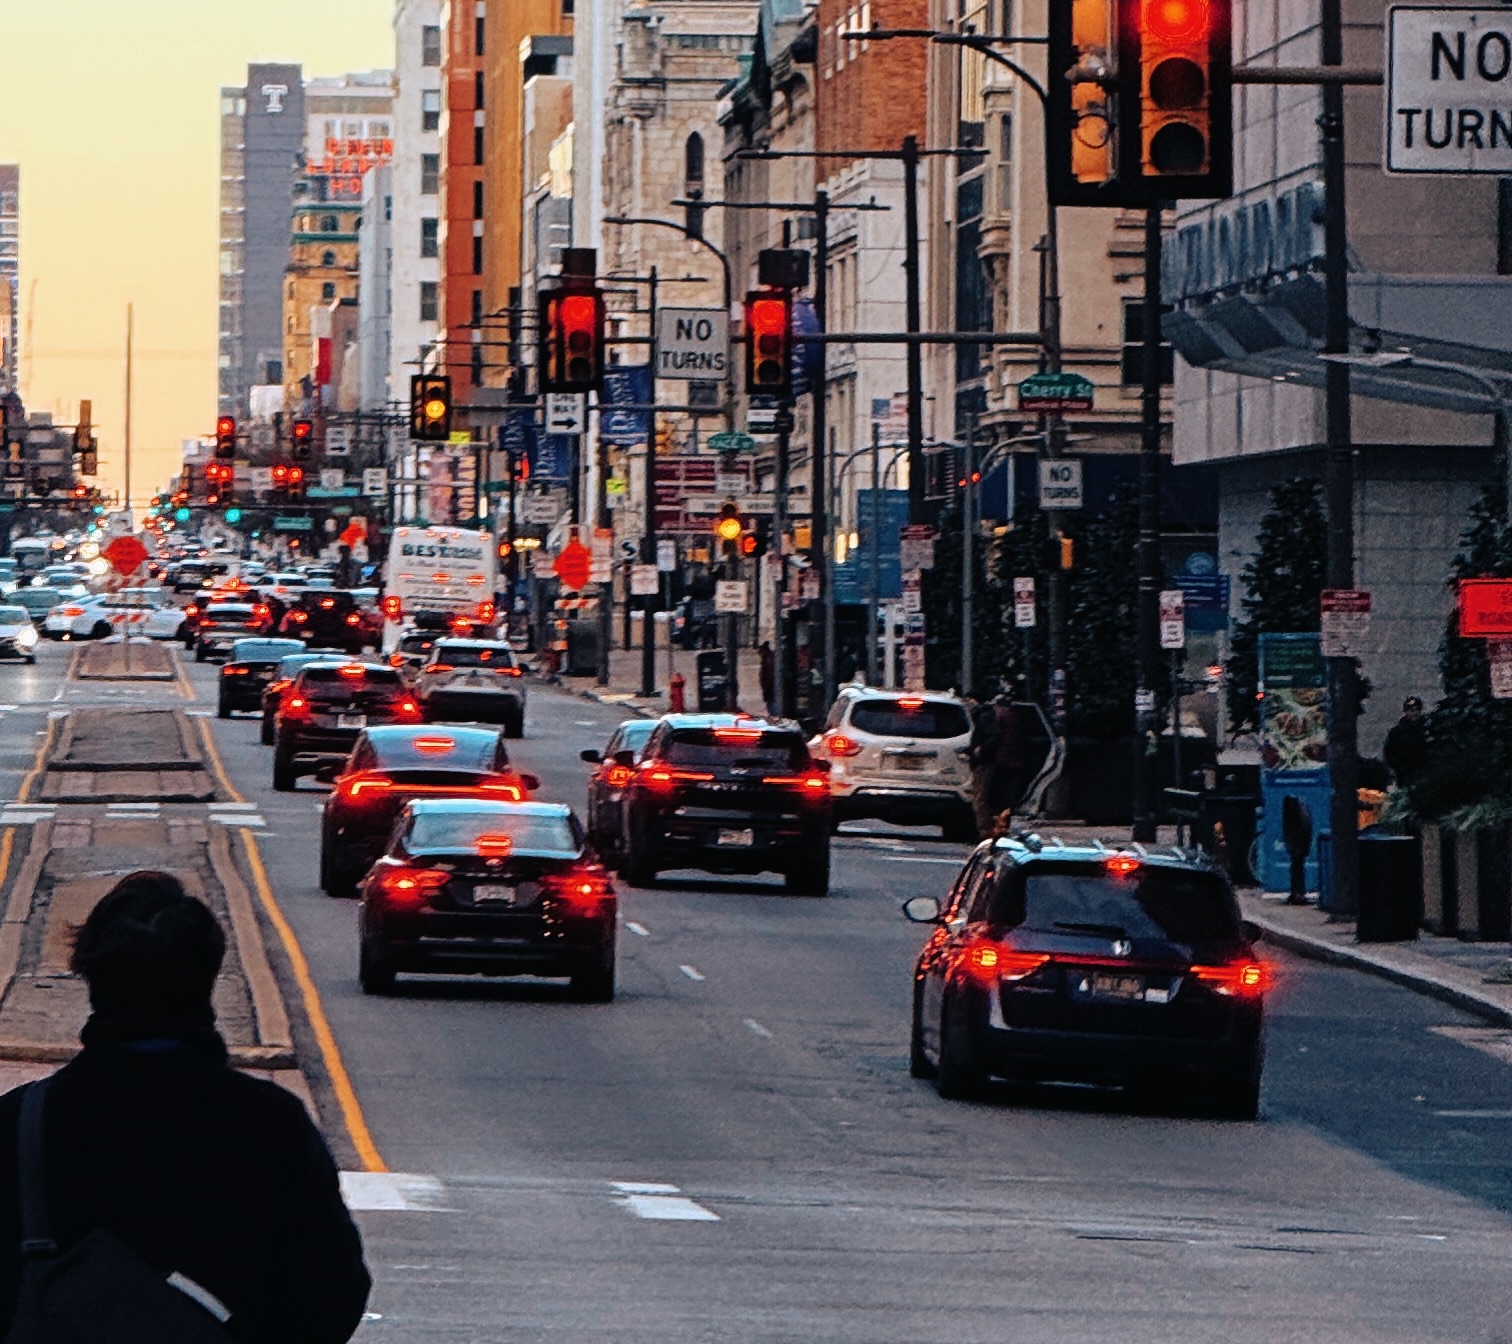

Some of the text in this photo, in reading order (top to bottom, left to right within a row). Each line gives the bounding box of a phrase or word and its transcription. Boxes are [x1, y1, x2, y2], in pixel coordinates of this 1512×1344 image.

[1431, 31, 1512, 82] NO
[261, 84, 288, 113] T
[676, 318, 712, 341] NO
[661, 350, 727, 371] TURNS
[1020, 383, 1071, 398] Cherry
[1050, 467, 1073, 482] NO
[1043, 487, 1080, 499] TURNS
